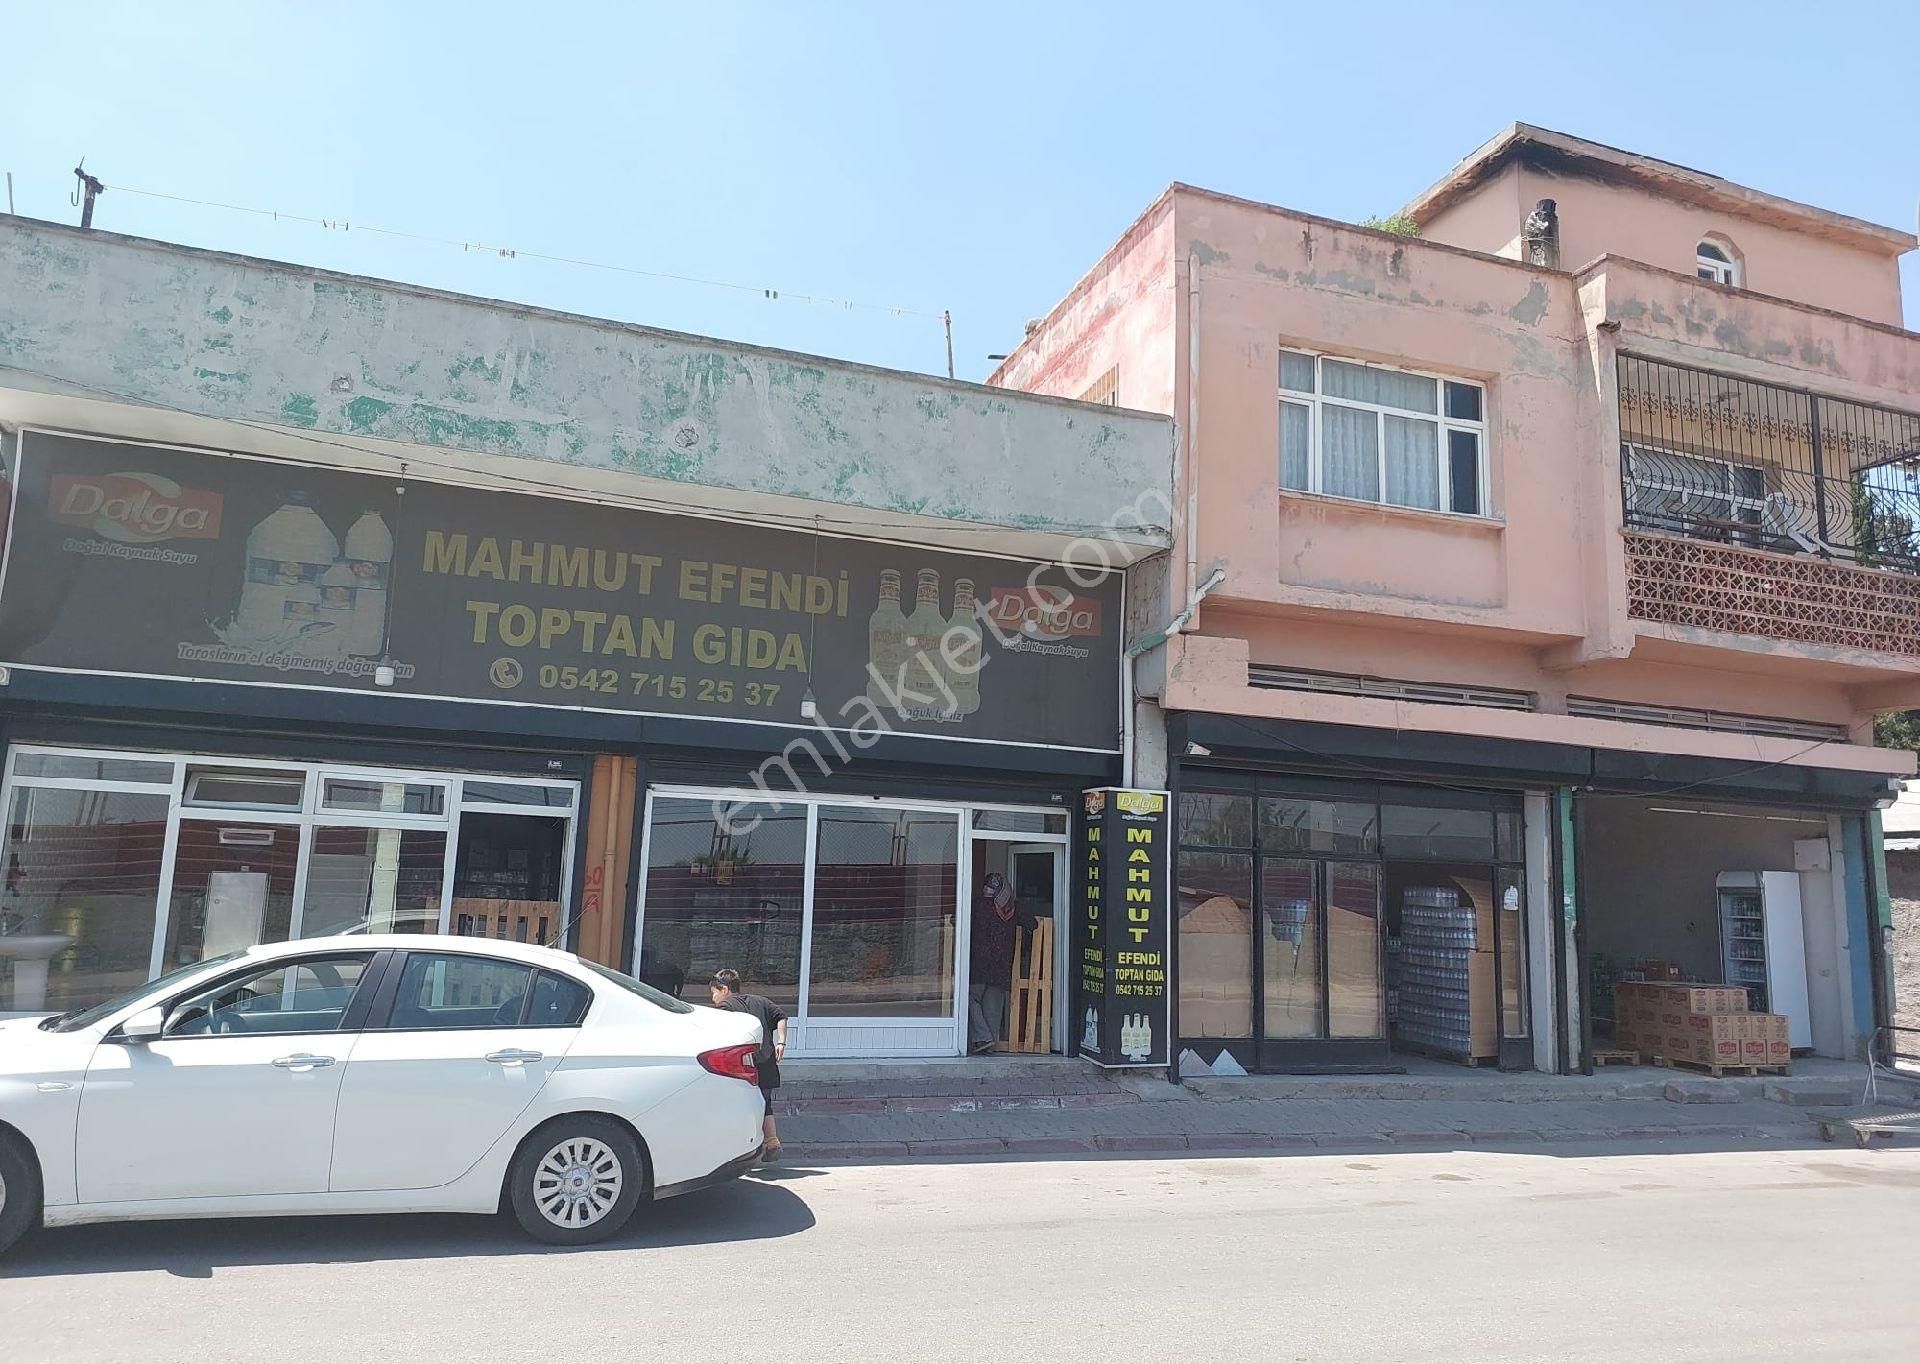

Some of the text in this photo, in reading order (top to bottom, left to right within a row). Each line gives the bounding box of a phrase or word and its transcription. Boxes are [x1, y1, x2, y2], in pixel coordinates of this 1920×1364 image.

[60, 483, 209, 534] Dalga
[422, 530, 849, 617] MAHMUT EFENDİ
[997, 594, 1093, 634] Dalga
[466, 599, 808, 673] TOPTAN GIDA
[539, 664, 782, 707] 0542 715 25 37
[1120, 796, 1160, 811] Dalga
[1088, 828, 1100, 940] MAHMUT
[1126, 828, 1152, 943] MAHMUT
[1084, 947, 1103, 962] EFENDİ
[1115, 968, 1144, 981] TOPTAN
[1118, 951, 1160, 966] EFENDİ
[1115, 984, 1163, 996] 0542 715 25 37
